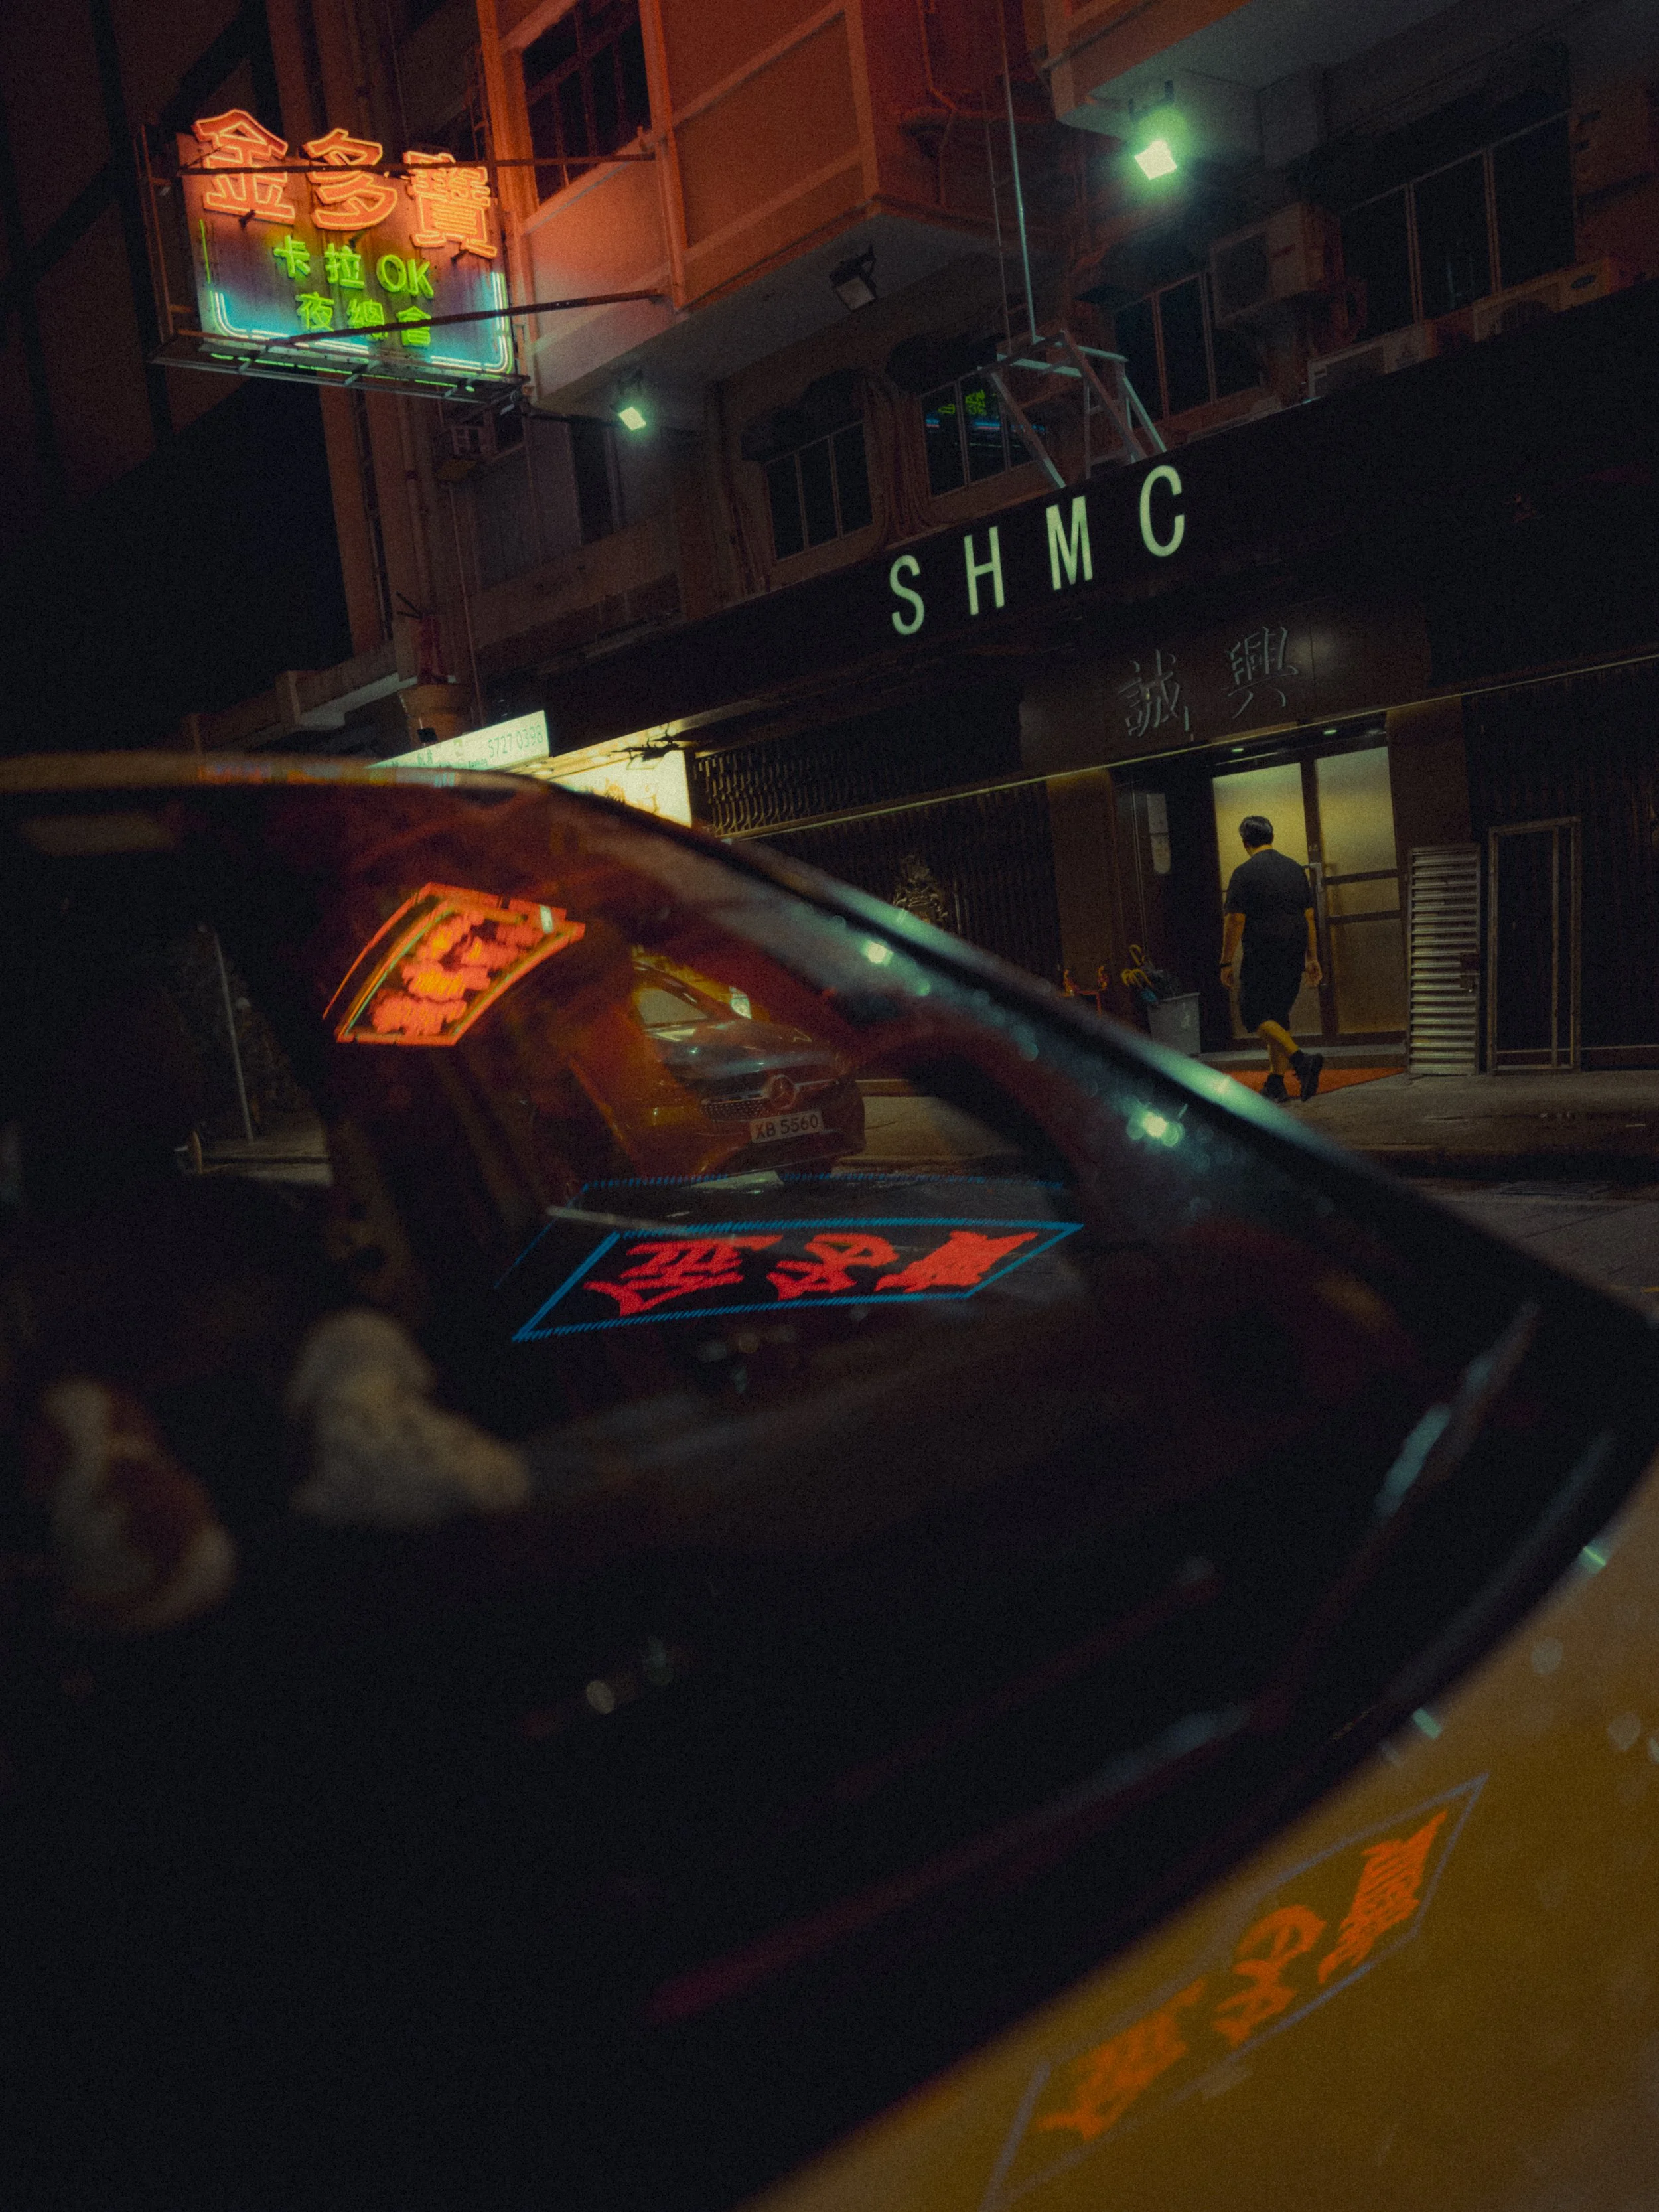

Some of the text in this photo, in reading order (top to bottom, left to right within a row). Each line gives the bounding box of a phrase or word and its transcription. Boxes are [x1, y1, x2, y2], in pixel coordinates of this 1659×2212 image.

[192, 108, 498, 259] 金多寶
[273, 234, 434, 299] 卡拉OK
[295, 291, 432, 347] 夜總會
[755, 1114, 818, 1139] XB 5560
